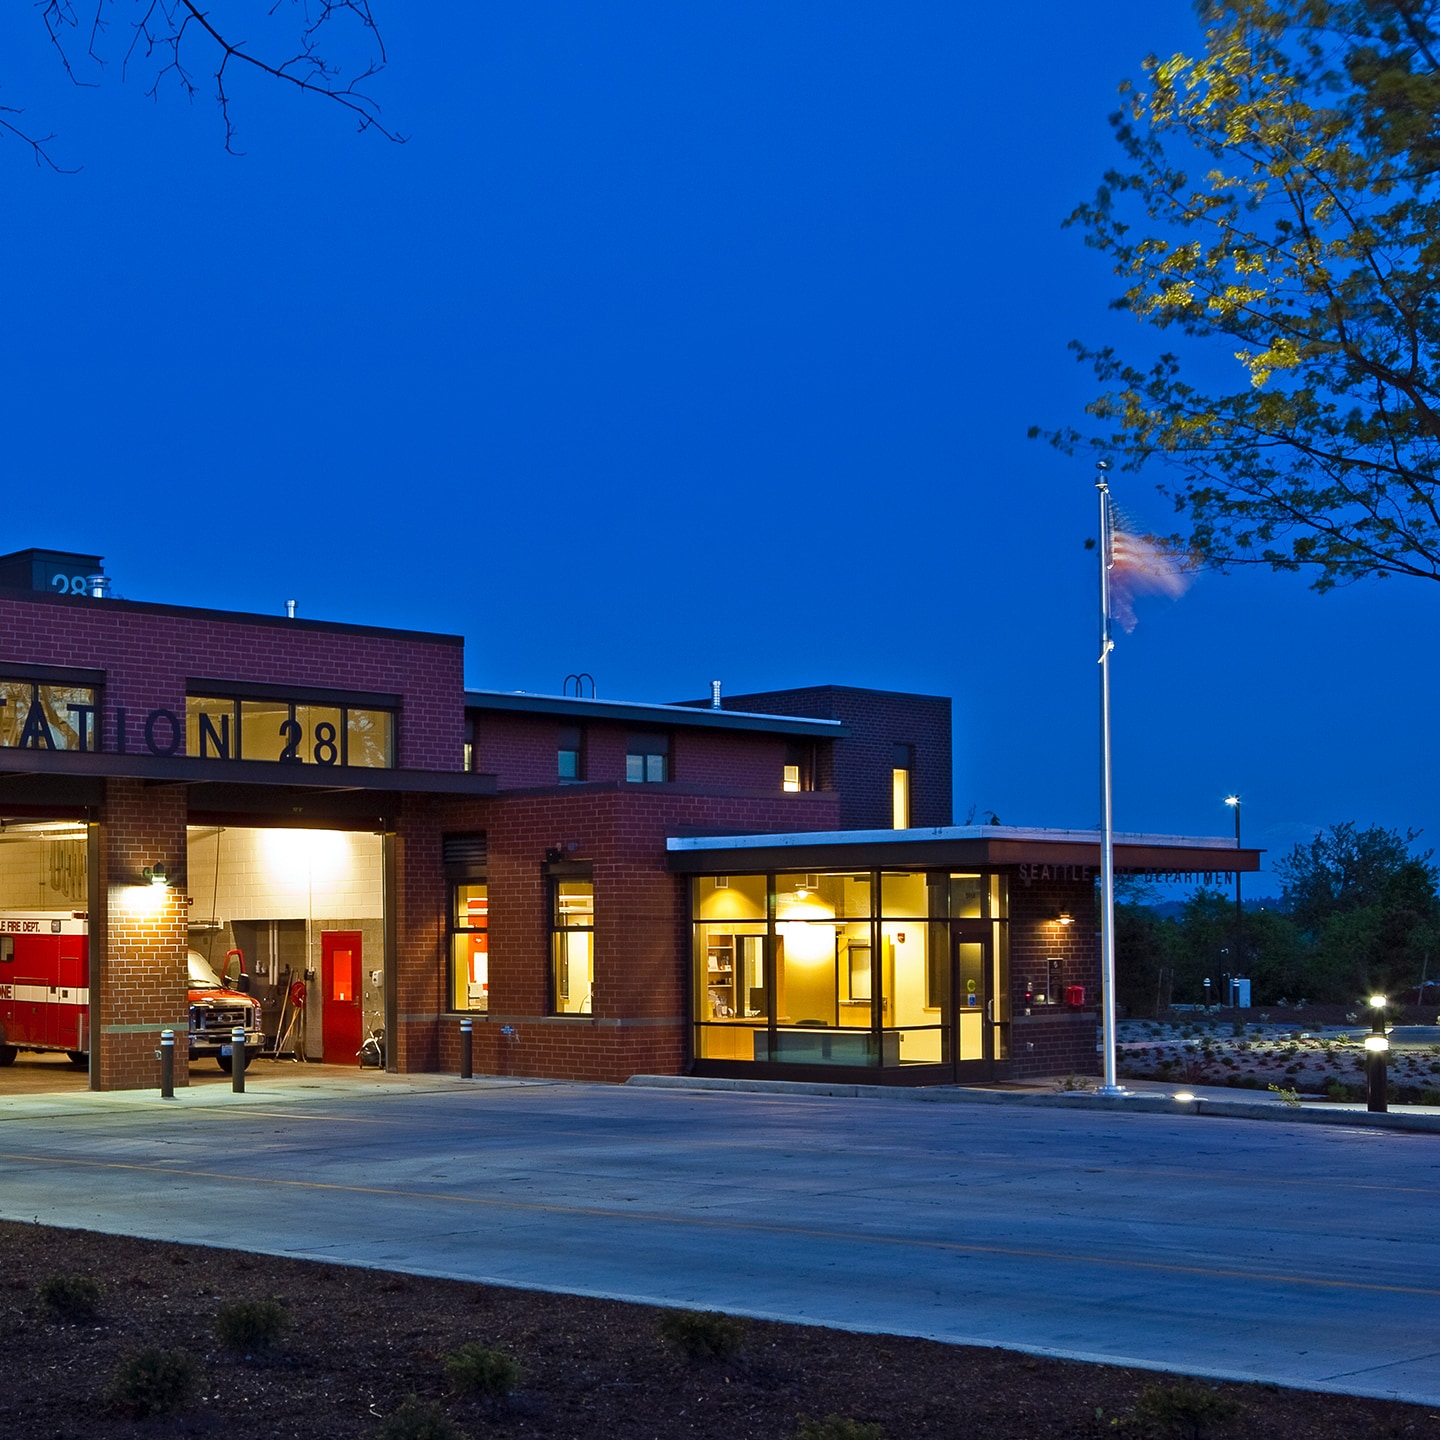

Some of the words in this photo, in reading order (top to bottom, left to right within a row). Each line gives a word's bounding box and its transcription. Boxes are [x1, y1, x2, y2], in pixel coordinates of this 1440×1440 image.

[52, 573, 87, 596] 28
[279, 719, 338, 766] 28
[1019, 864, 1090, 882] SEATTLE
[7, 922, 21, 932] FIRE
[23, 922, 40, 933] DEPT.
